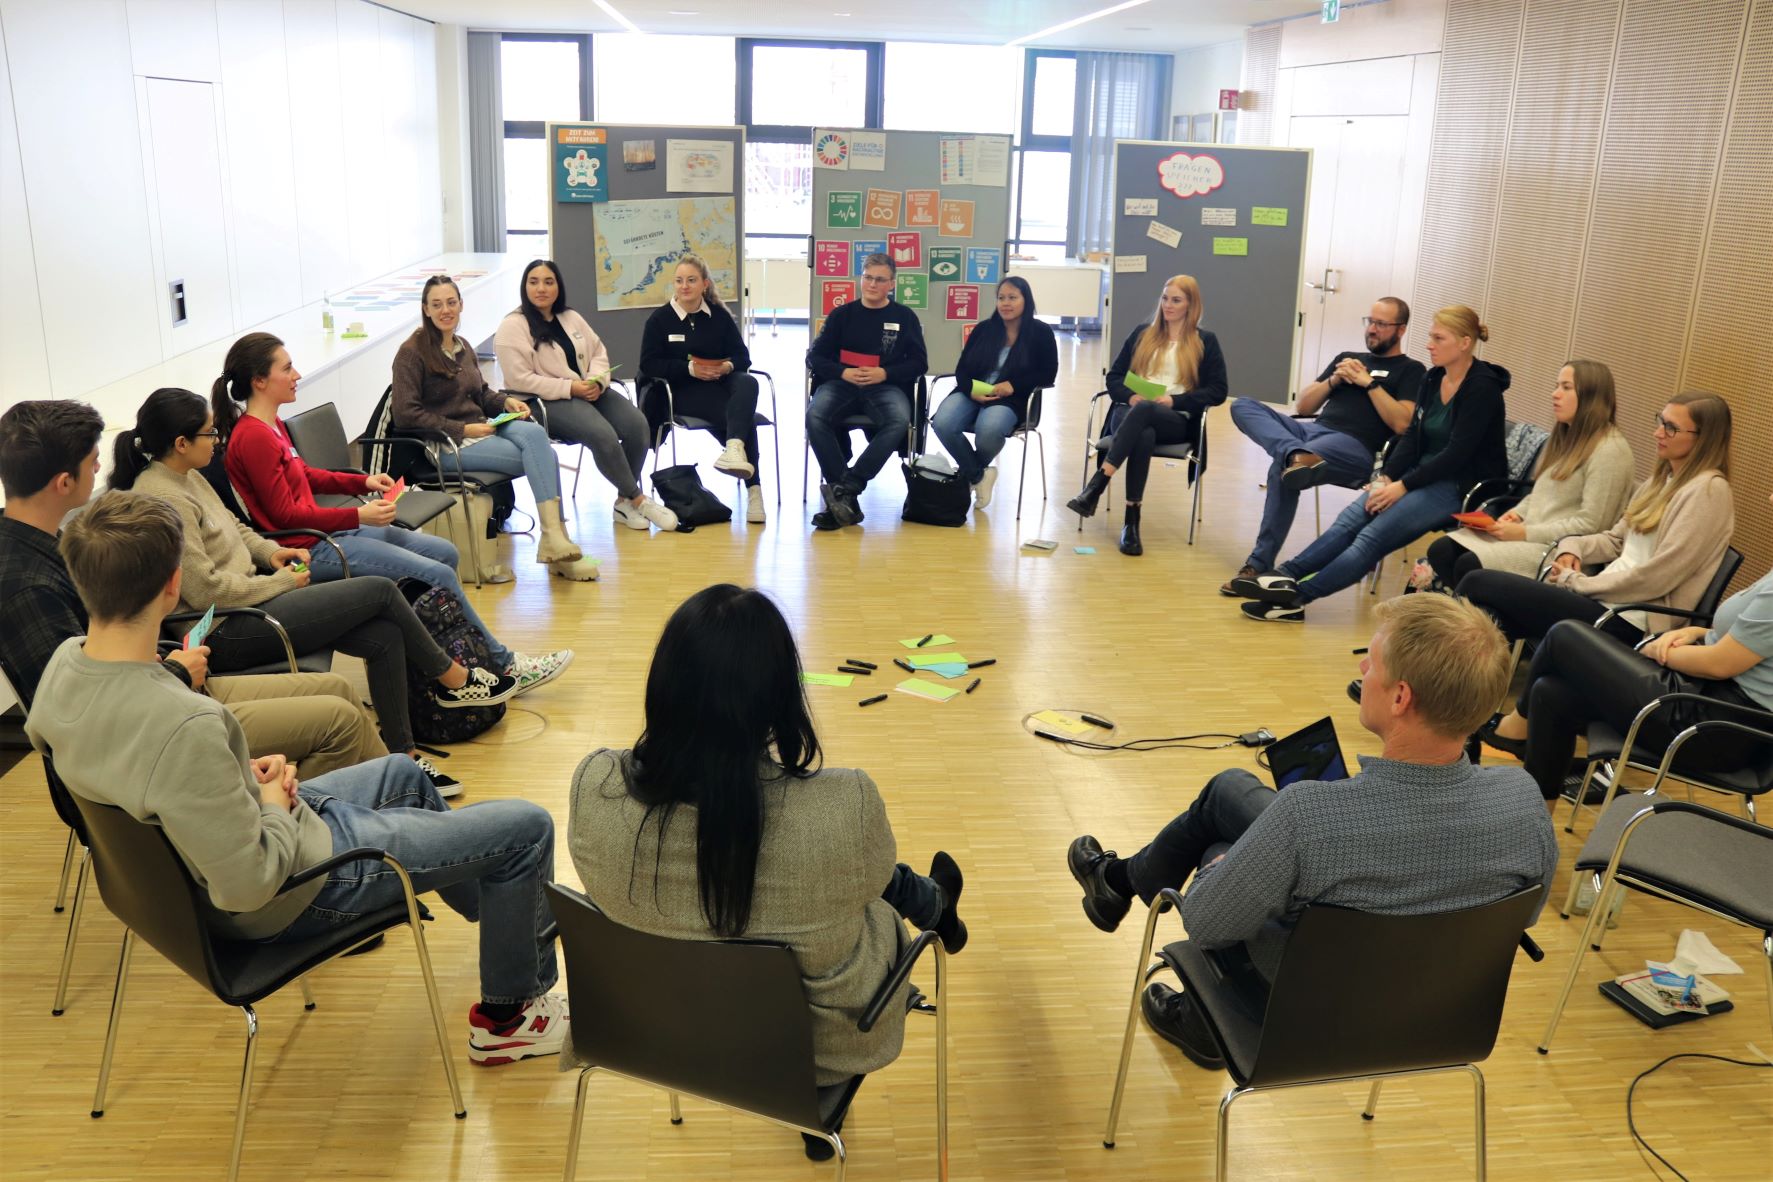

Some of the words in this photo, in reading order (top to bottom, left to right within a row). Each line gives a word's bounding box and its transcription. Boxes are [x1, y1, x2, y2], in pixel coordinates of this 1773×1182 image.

[1172, 162, 1211, 175] FRAGEN
[830, 194, 836, 203] 3
[818, 243, 826, 252] 10
[855, 243, 863, 252] 14
